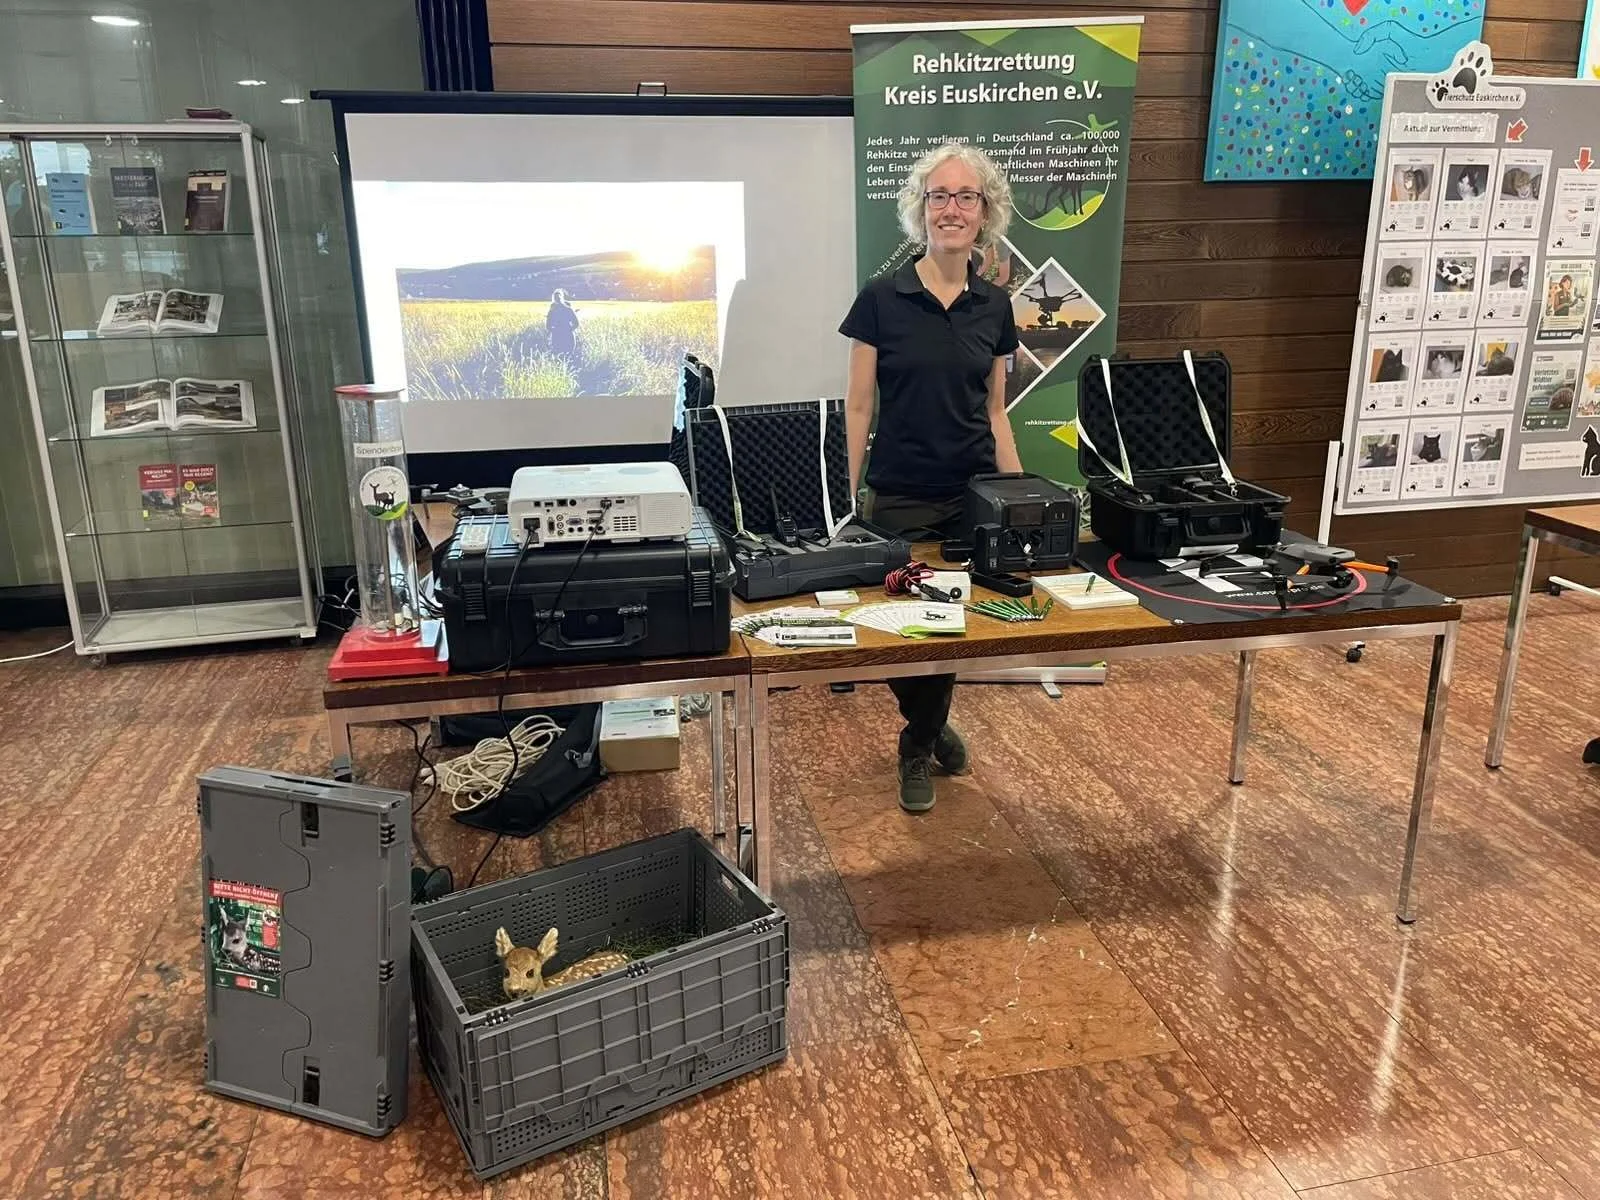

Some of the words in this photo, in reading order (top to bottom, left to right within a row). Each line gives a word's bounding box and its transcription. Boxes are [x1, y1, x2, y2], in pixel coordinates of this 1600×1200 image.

[913, 53, 1076, 75] Rehkitzrettung
[885, 85, 937, 105] Kreis
[942, 82, 1059, 104] Euskirchen
[1064, 80, 1103, 101] e.V.
[1443, 92, 1475, 102] Tierschutz
[1476, 92, 1509, 102] Euskirchen
[866, 136, 893, 146] Jedes
[900, 135, 920, 145] Jahr
[927, 134, 969, 145] verlieren
[976, 134, 986, 143] in
[992, 132, 1054, 142] Deutschland
[1060, 132, 1074, 141] ca.
[1082, 130, 1120, 140] 100.000
[866, 150, 908, 160] Rehkitze
[1029, 145, 1042, 155] im
[1046, 144, 1088, 157] Frühjahr
[1091, 143, 1119, 154] durch
[866, 164, 885, 173] den
[888, 163, 913, 173] Einsa
[1048, 158, 1101, 168] Maschinen
[867, 177, 895, 187] Leben
[1009, 173, 1044, 183] Messer
[1046, 172, 1064, 182] der
[1066, 171, 1118, 182] Maschinen
[880, 260, 892, 272] zu
[213, 883, 232, 891] BITTE
[232, 885, 251, 893] NICHT
